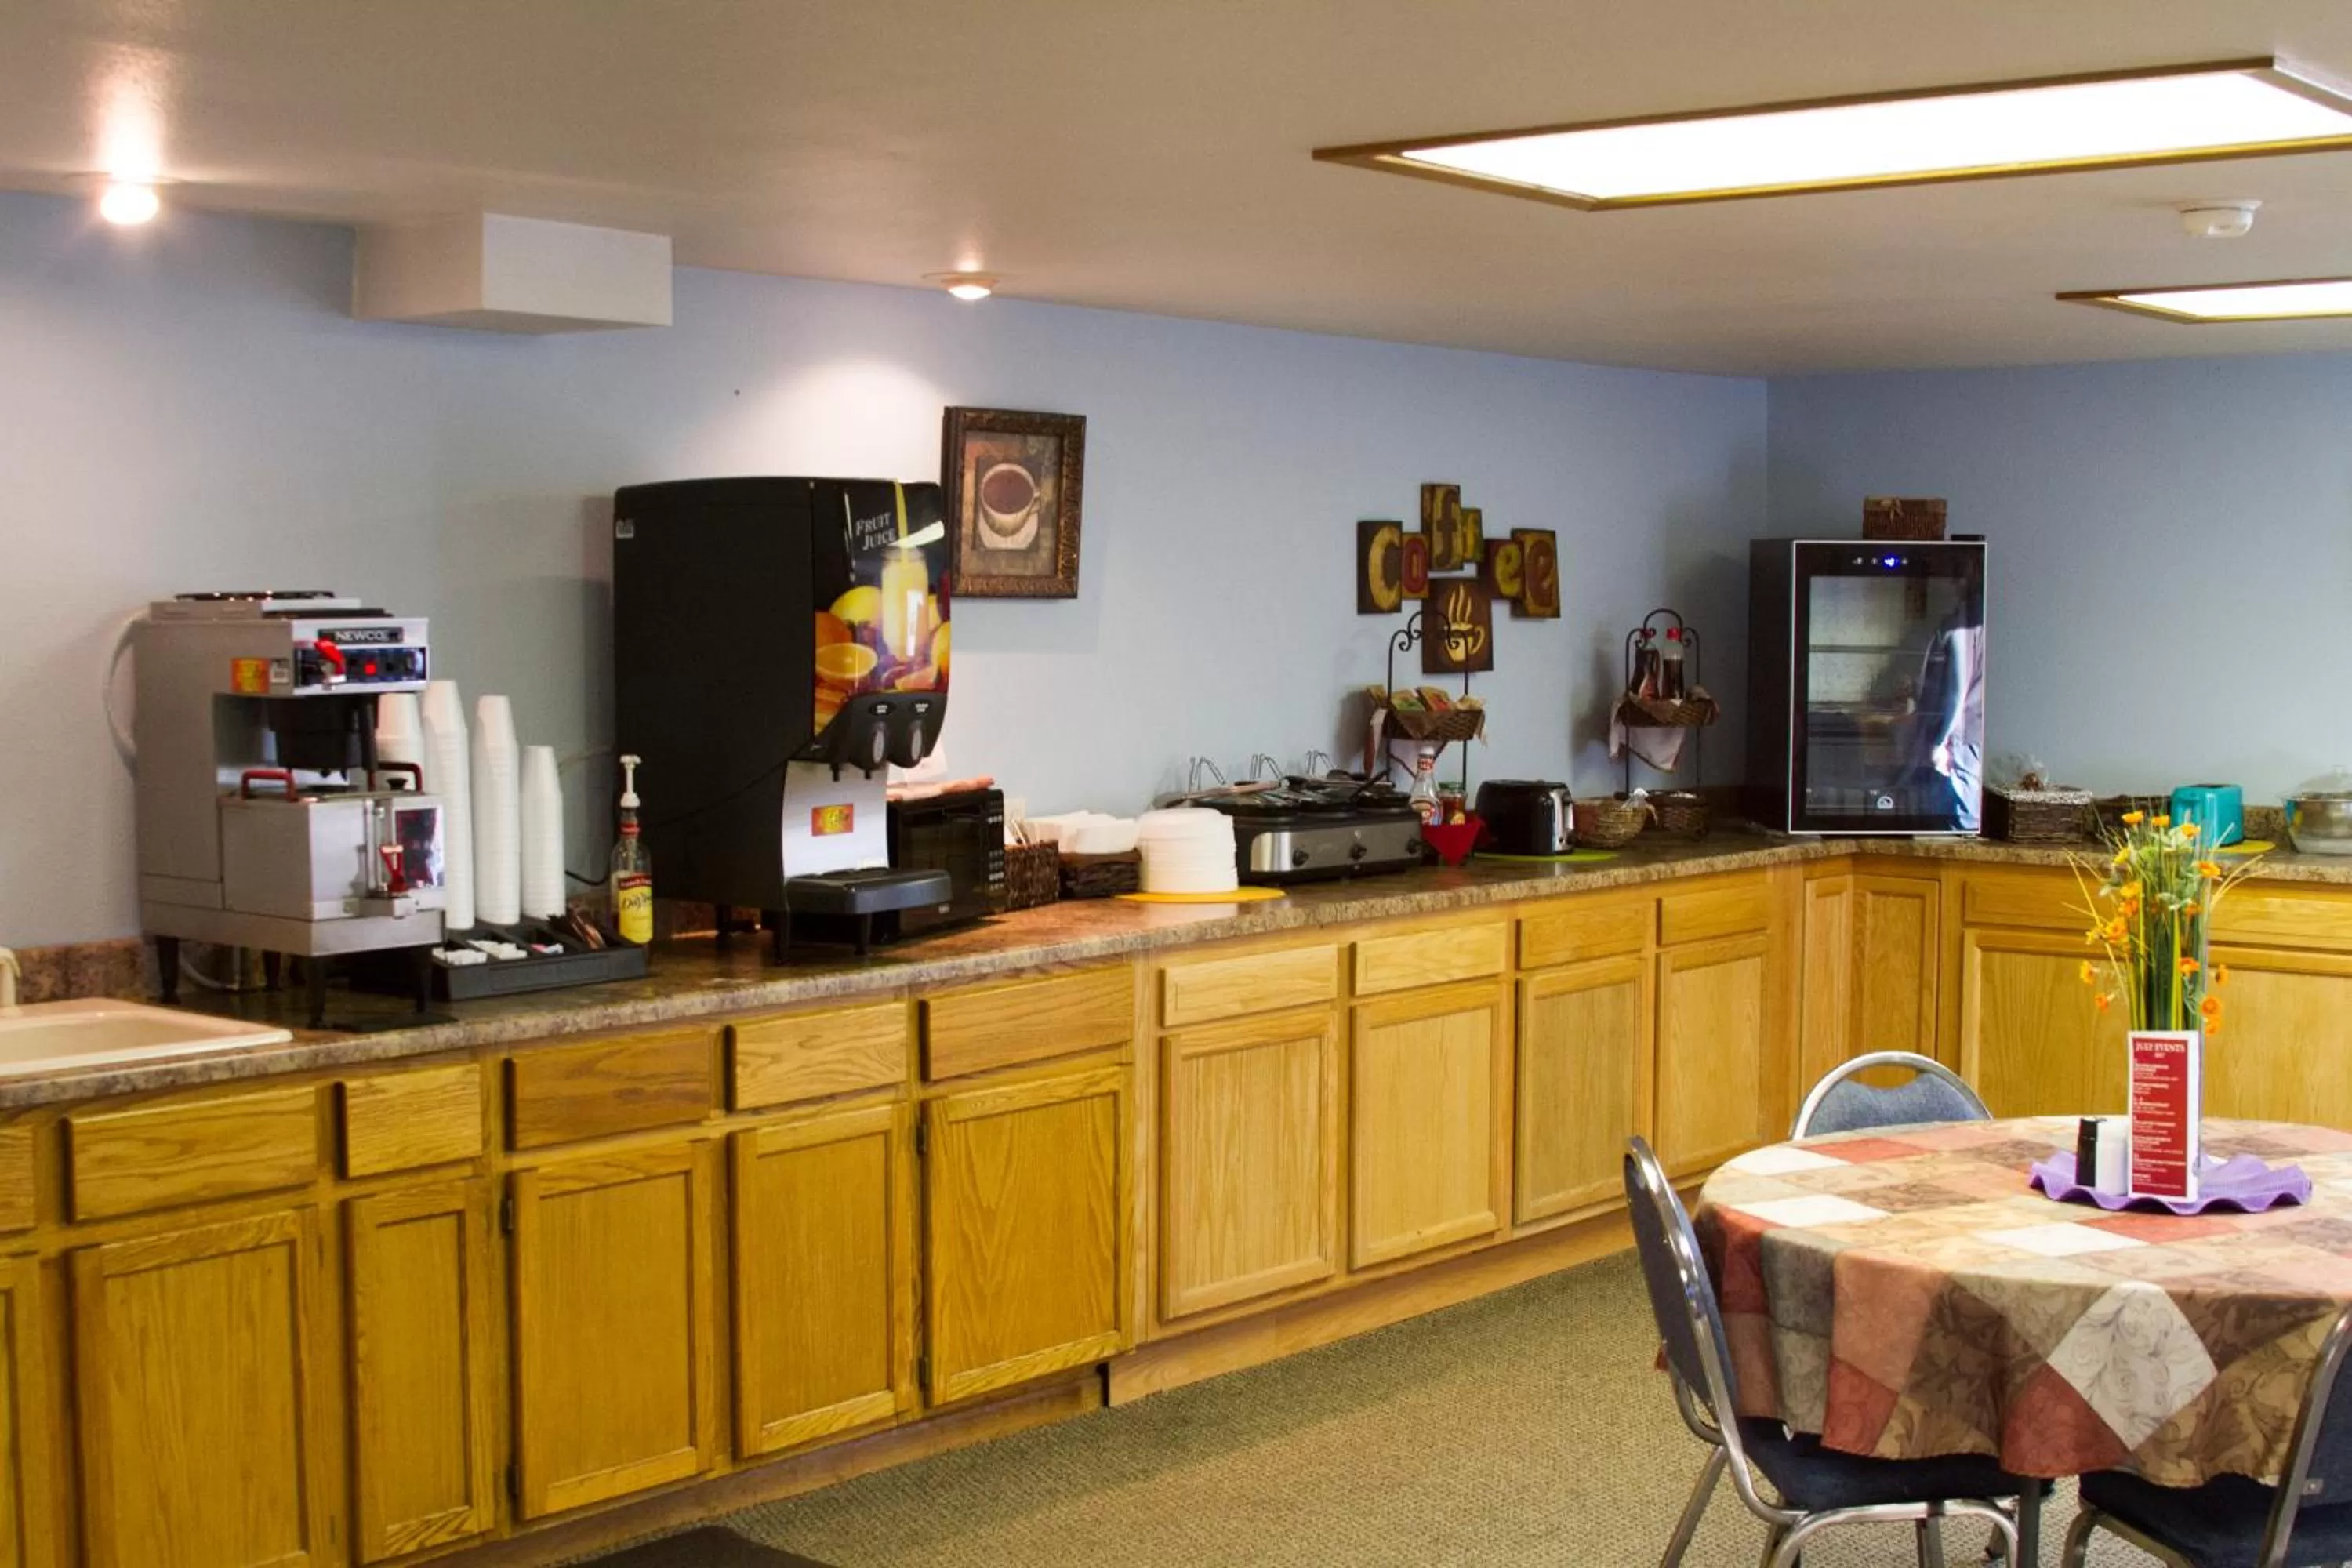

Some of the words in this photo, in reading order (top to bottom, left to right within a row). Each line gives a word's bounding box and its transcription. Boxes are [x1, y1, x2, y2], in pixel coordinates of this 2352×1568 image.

[855, 511, 891, 537] FRUIT
[862, 528, 895, 551] JUICE
[335, 630, 385, 641] NEWCO
